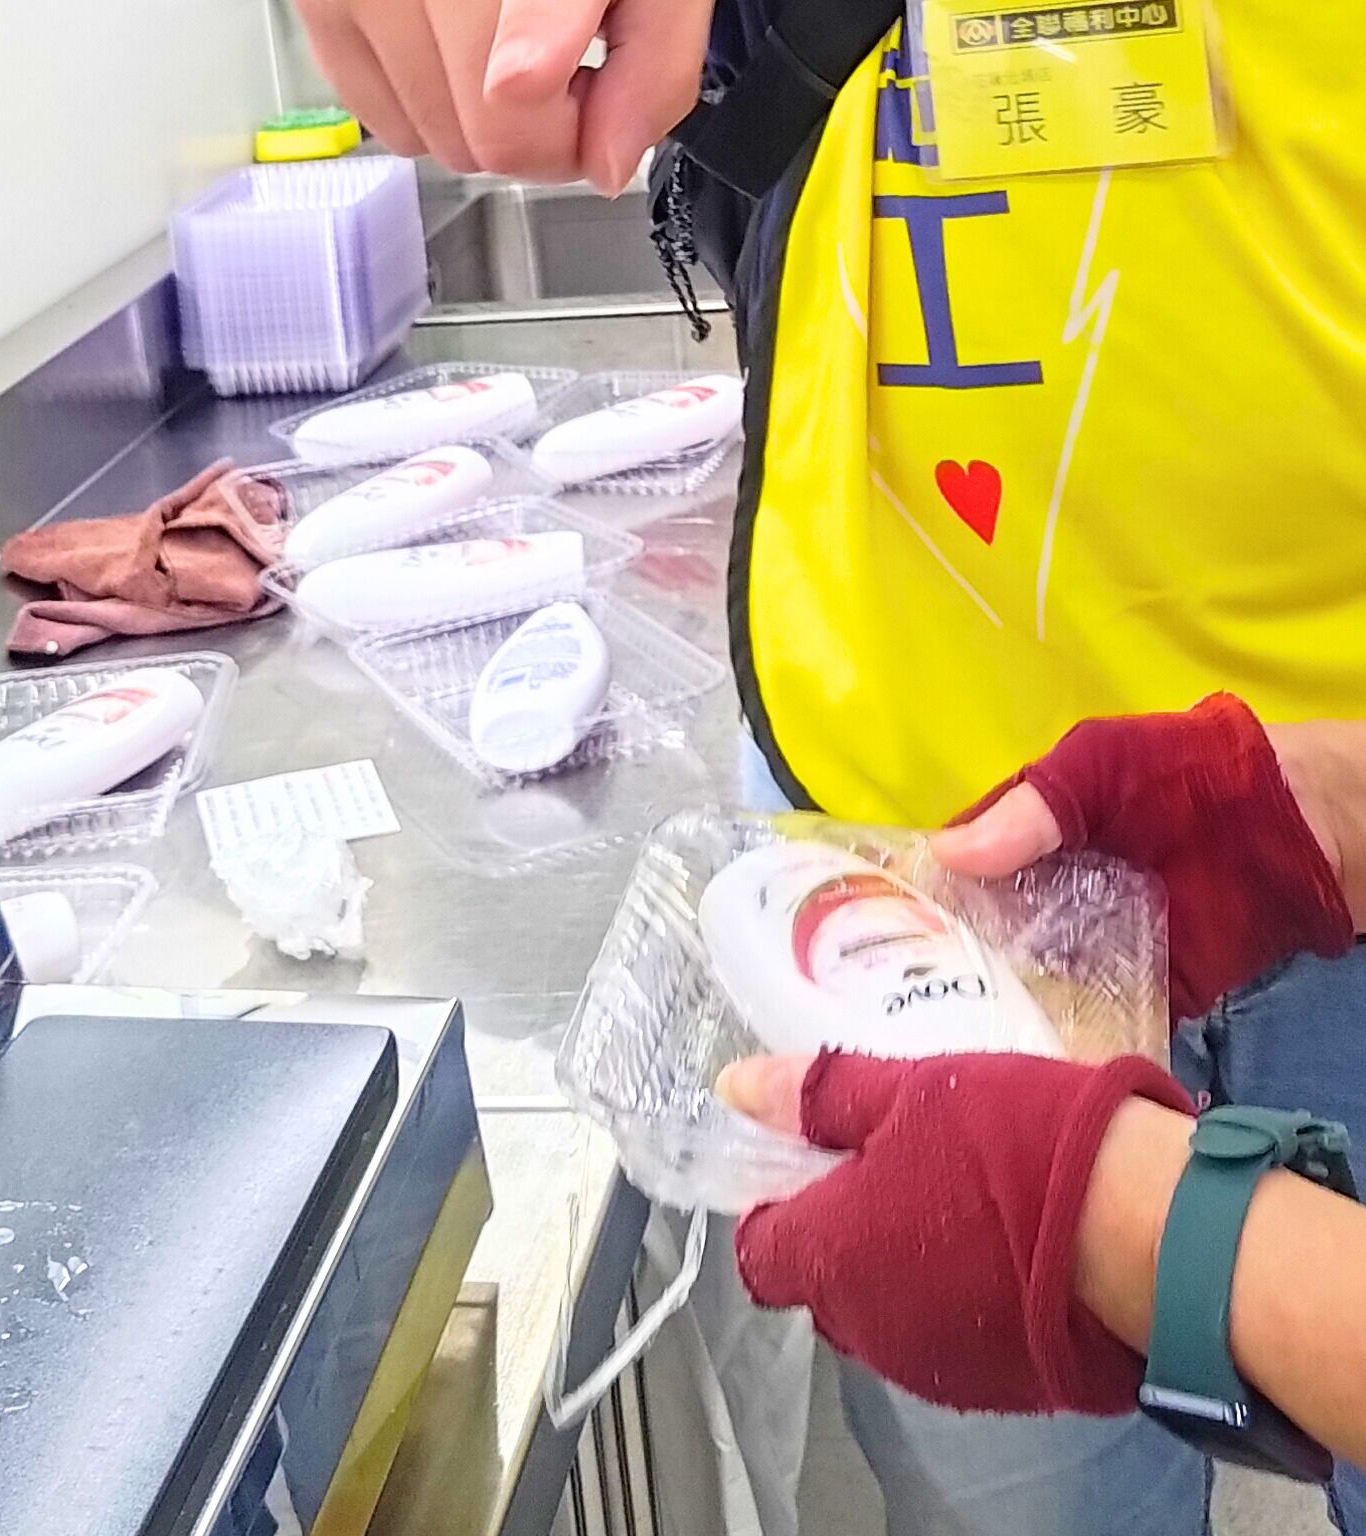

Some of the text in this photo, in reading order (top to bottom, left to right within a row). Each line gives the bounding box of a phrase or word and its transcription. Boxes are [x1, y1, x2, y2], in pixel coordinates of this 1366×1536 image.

[1010, 1, 1169, 41] 全聯福利中心
[993, 81, 1168, 146] 張 豪
[883, 972, 988, 1017] Dove
